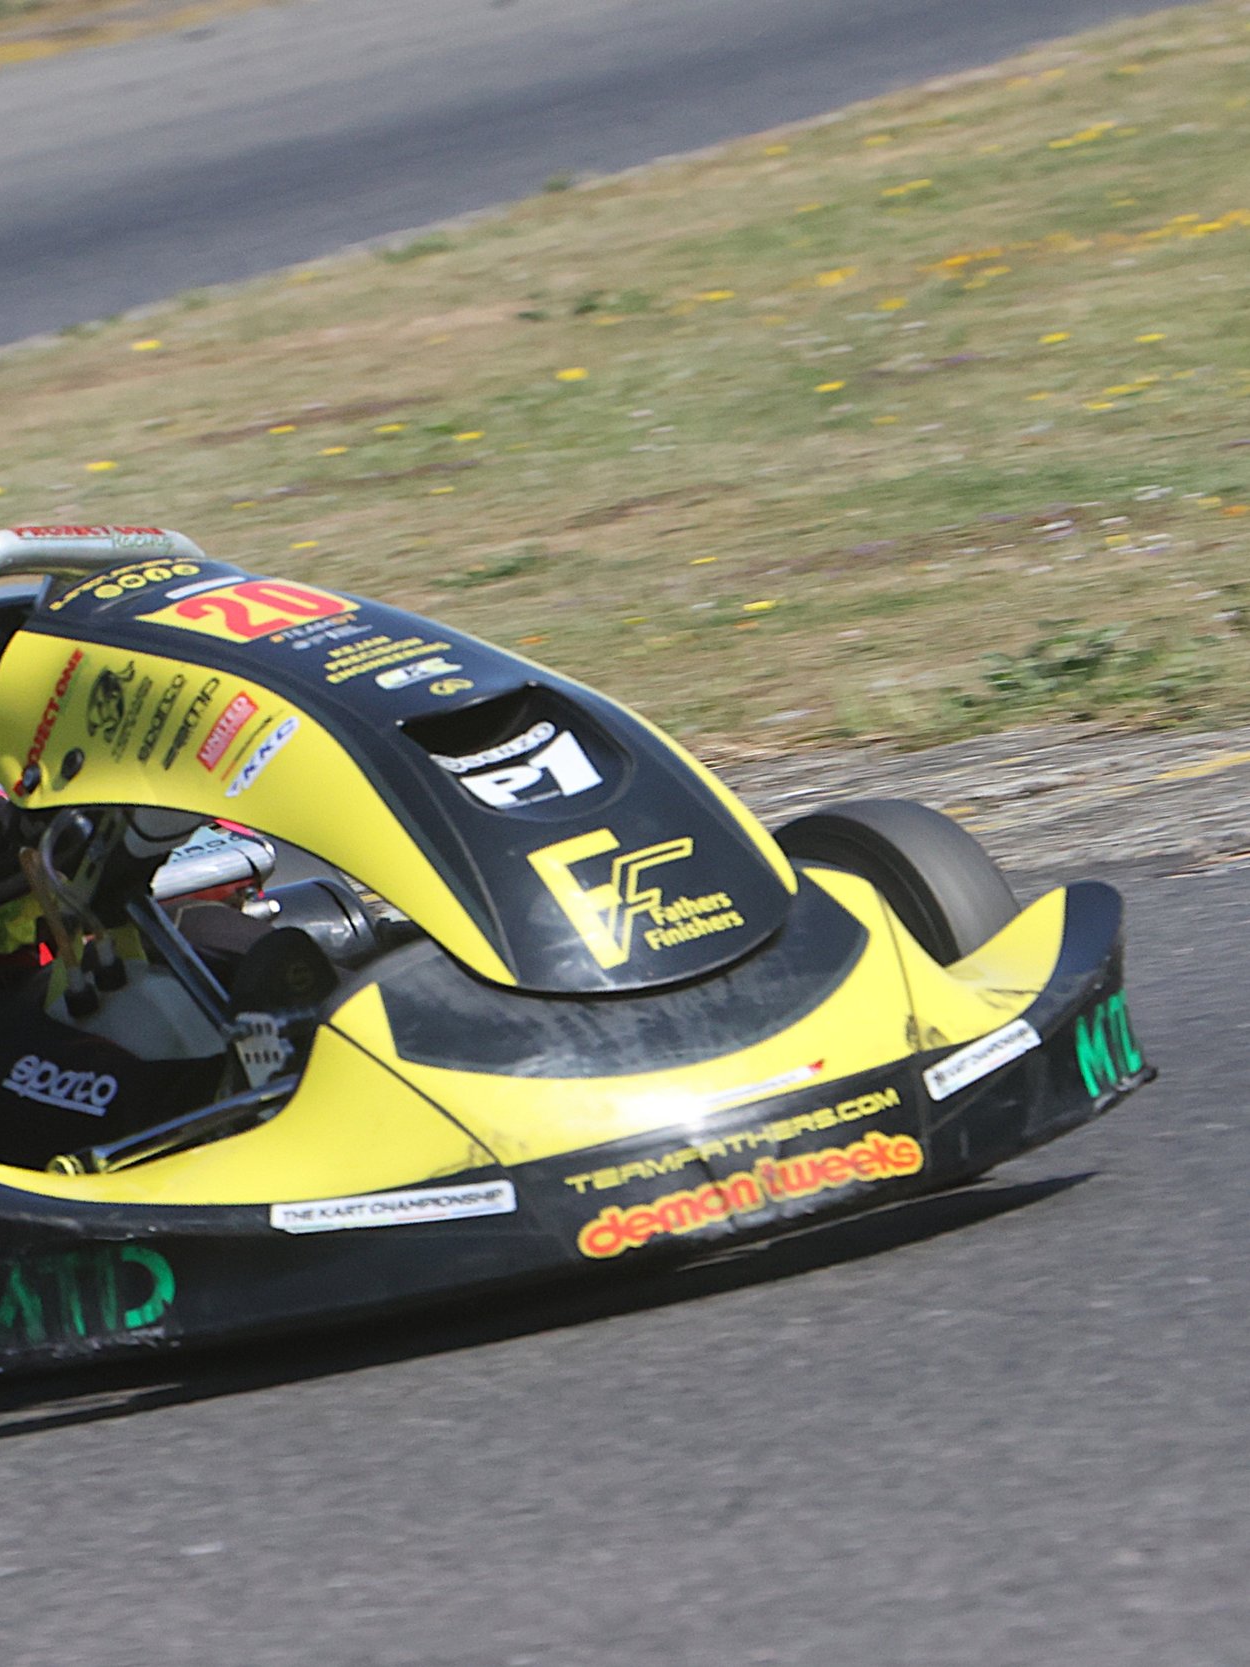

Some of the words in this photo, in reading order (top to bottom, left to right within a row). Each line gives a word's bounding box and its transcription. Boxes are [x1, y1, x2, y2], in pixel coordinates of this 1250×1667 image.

[176, 582, 346, 639] 20
[12, 697, 60, 798] POJECT
[643, 910, 745, 952] Finishers
[649, 891, 733, 927] Fathers
[282, 1209, 314, 1223] THE
[319, 1203, 364, 1218] KART
[579, 1173, 763, 1258] demon
[757, 1132, 923, 1195] tweeks
